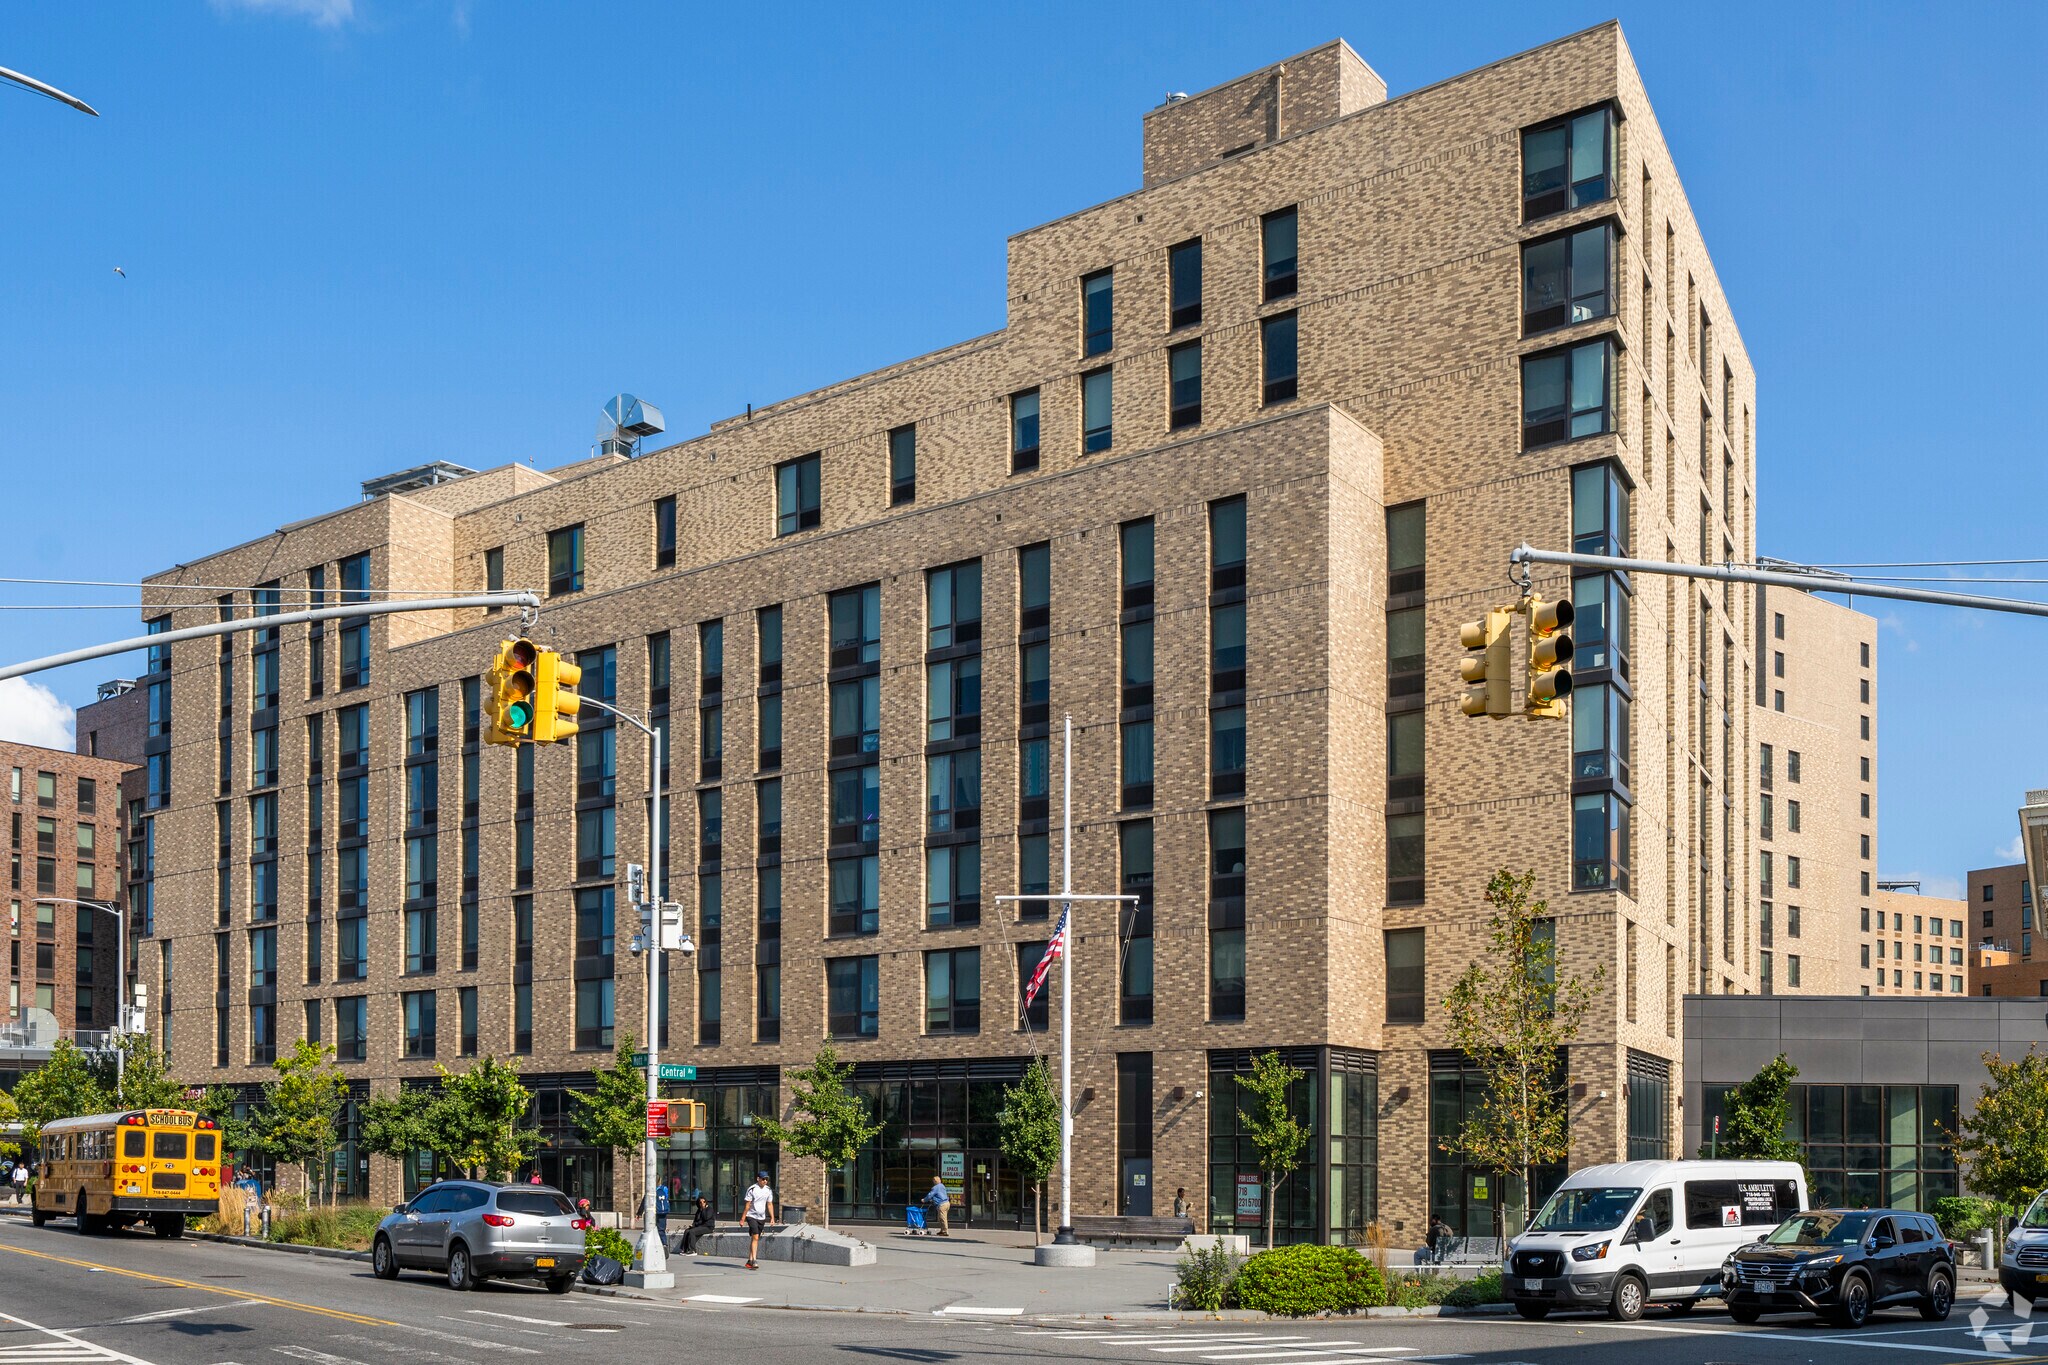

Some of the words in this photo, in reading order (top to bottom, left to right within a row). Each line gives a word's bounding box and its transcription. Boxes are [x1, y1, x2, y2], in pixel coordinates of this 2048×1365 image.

[661, 1066, 686, 1077] Central
[150, 1114, 177, 1125] SCHOOL
[178, 1115, 192, 1125] BUS
[1238, 1187, 1248, 1196] 718
[1748, 1184, 1775, 1192] AMBULETTE
